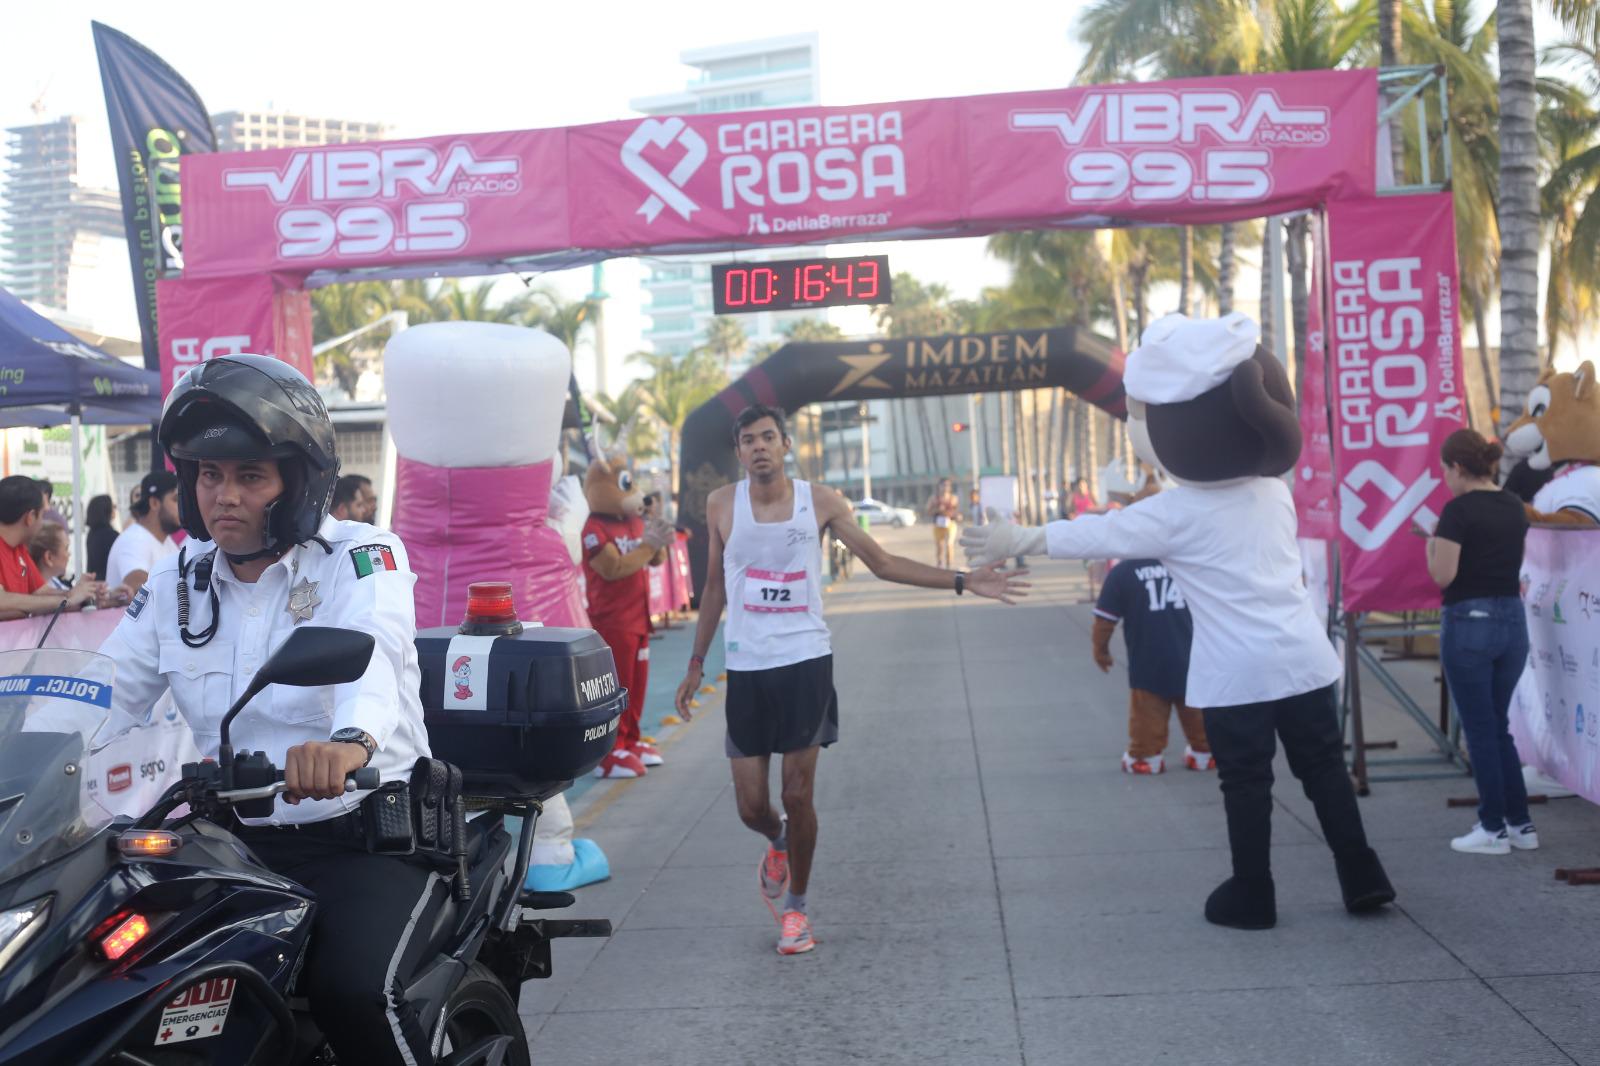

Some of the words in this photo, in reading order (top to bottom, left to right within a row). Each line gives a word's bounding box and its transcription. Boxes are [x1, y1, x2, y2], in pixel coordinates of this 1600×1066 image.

[718, 111, 902, 153] CARRERA
[1013, 93, 1325, 144] VIBRA
[1261, 130, 1325, 143] RADIO
[226, 146, 517, 202] VIBRA
[457, 178, 517, 193] RADIO
[720, 144, 906, 209] ROSA
[1069, 151, 1269, 200] 99.5
[279, 203, 467, 257] 99.5
[905, 332, 1049, 368] IMDEM
[1334, 260, 1374, 450] CARRERA
[1367, 257, 1429, 448] ROSA
[761, 588, 791, 601] 172
[141, 760, 165, 782] signo
[162, 1008, 227, 1026] EMERGENCIAS
